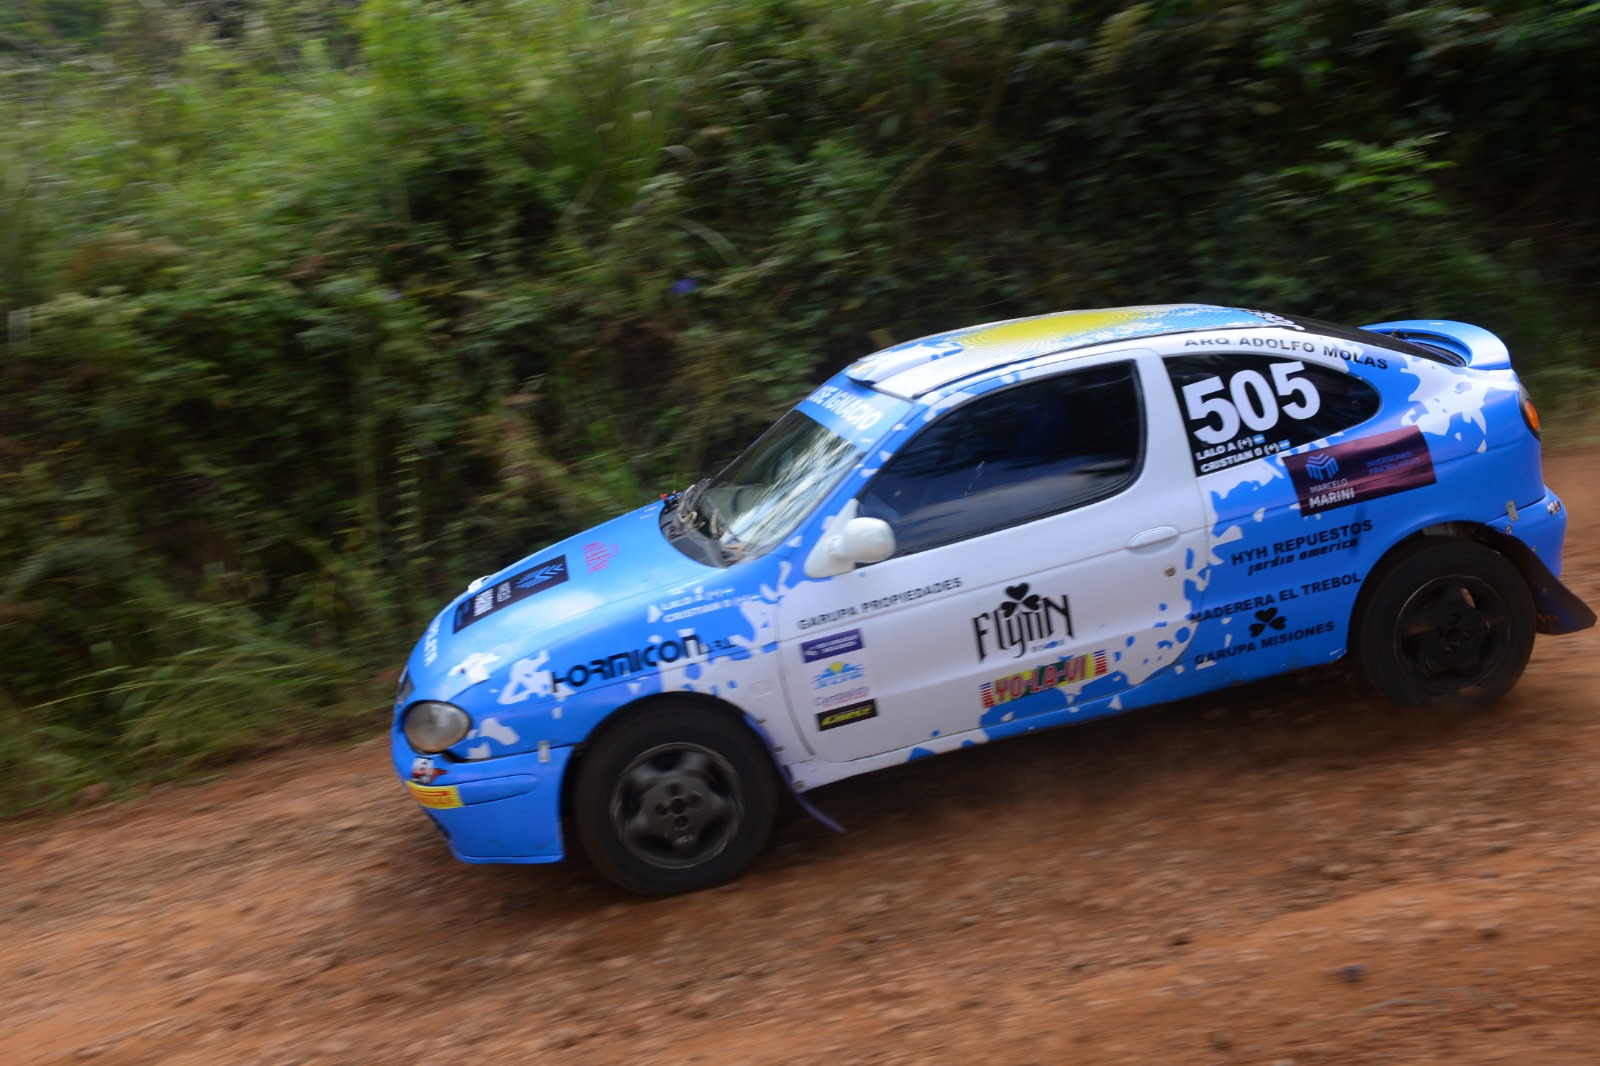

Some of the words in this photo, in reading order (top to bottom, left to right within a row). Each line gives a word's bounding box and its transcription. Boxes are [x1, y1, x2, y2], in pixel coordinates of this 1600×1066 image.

[1239, 337, 1315, 353] ADOLFO
[1323, 344, 1388, 370] MOLAS
[822, 390, 884, 430] IGNACIO
[1181, 361, 1321, 445] 505
[1200, 450, 1254, 473] CRISTIAN
[1308, 487, 1355, 508] MARINI
[1309, 478, 1348, 494] MARCELO
[1231, 548, 1268, 566] HYH
[1273, 519, 1373, 551] REPUESTOS
[1247, 554, 1295, 576] jardin
[1299, 537, 1358, 561] america
[797, 606, 859, 630] GARUPA
[860, 576, 963, 611] PROPIEDADES
[1190, 593, 1275, 624] MADERERA
[1279, 588, 1298, 602] EL
[1301, 572, 1362, 597] TREBOL
[1194, 642, 1257, 666] GARUPA
[1261, 620, 1335, 649] MISIONES
[995, 654, 1087, 702] YO-LA-VI
